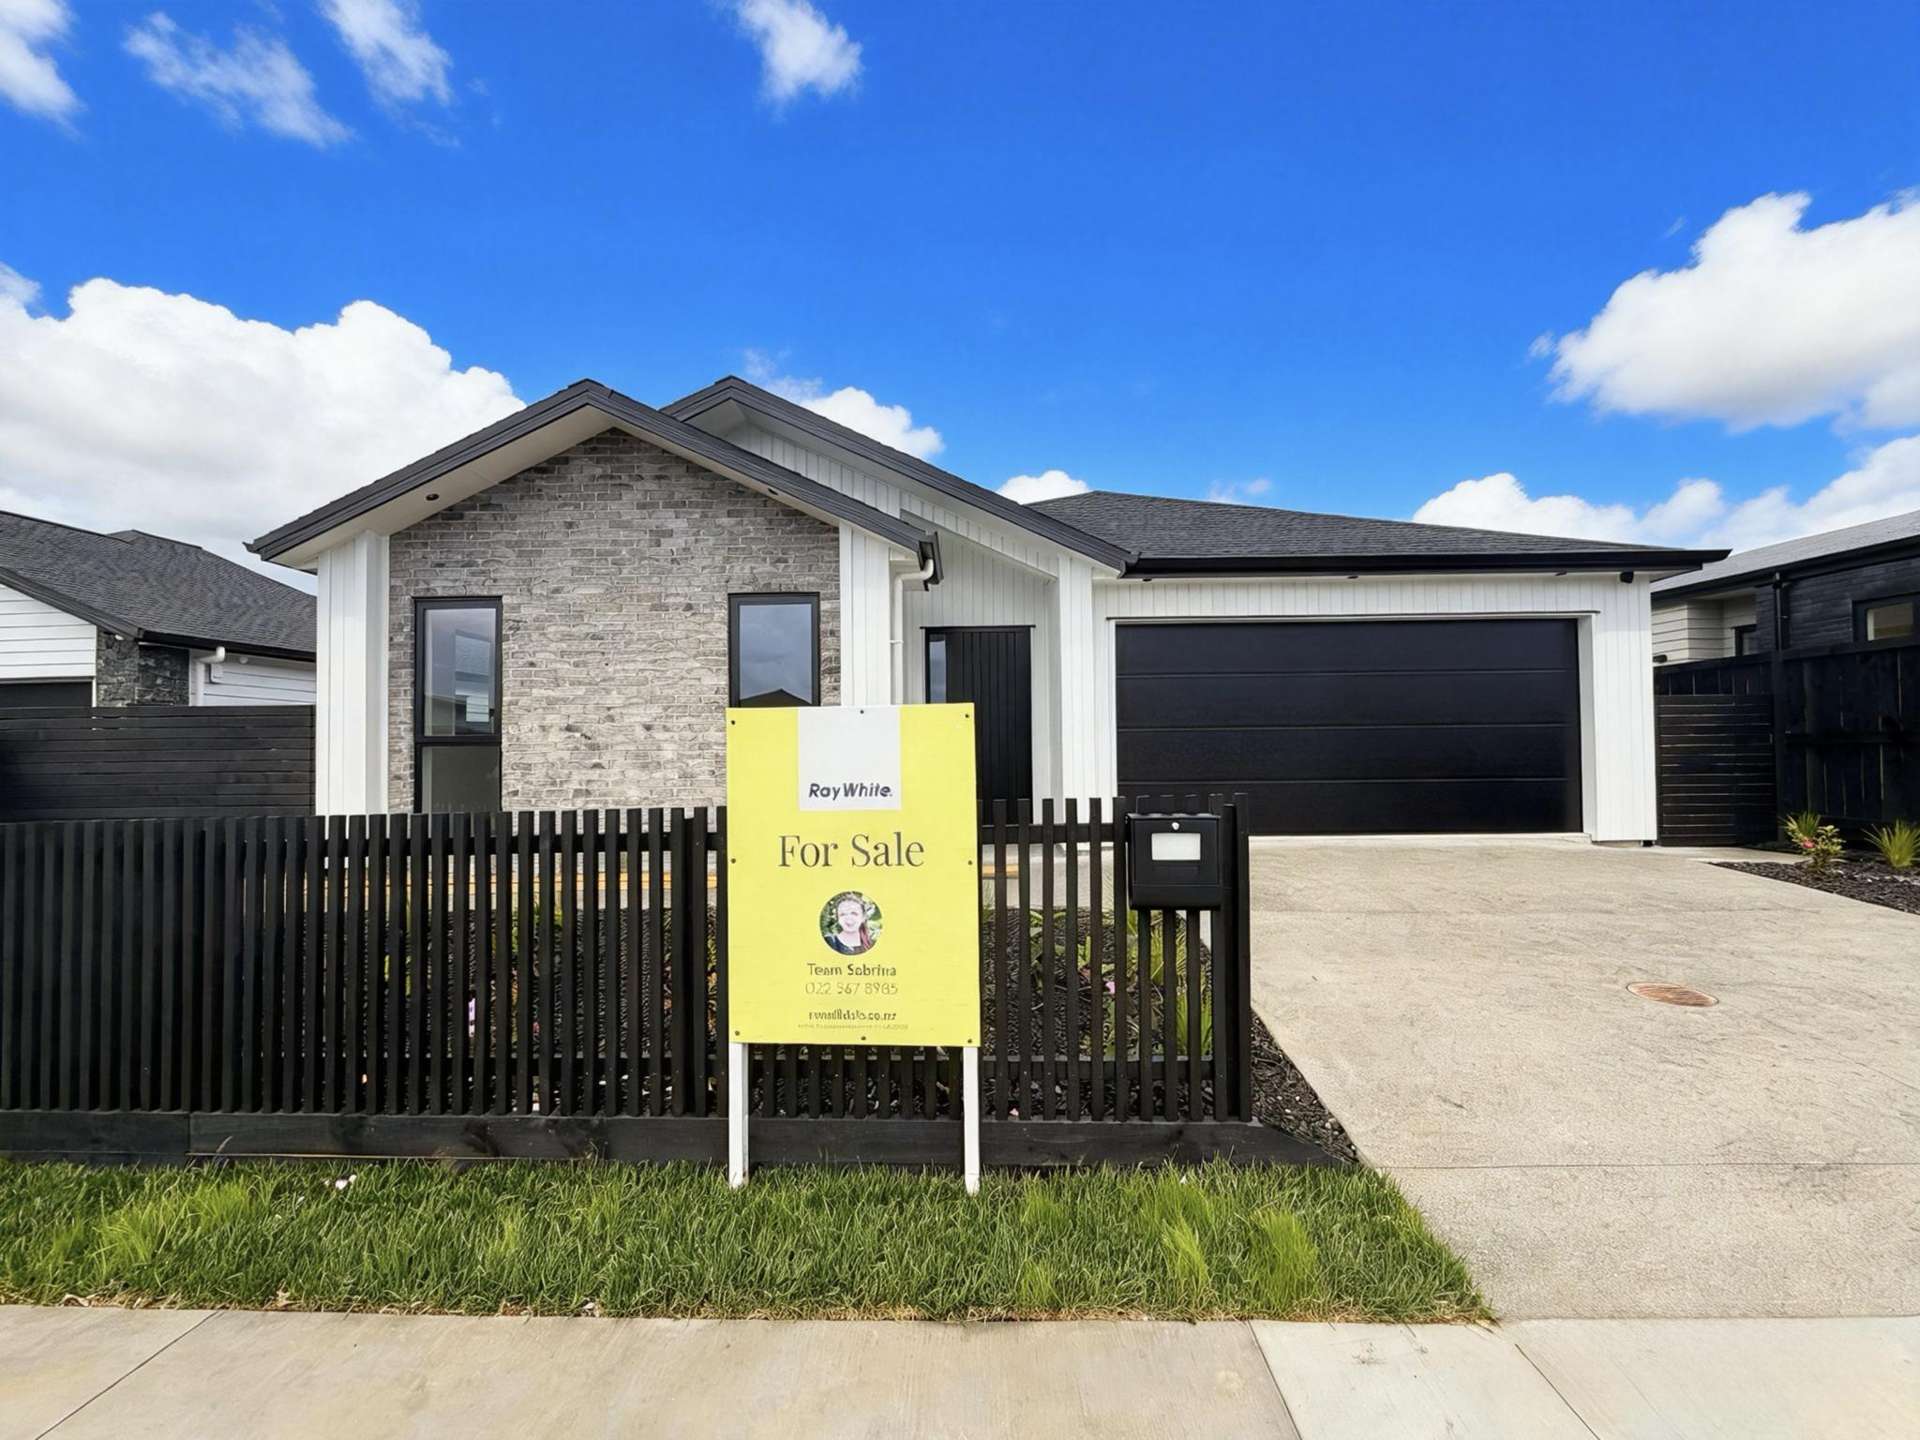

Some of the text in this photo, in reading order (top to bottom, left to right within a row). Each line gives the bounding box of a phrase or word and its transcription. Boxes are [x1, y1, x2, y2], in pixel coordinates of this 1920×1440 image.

[808, 783, 841, 801] Ray
[778, 831, 925, 868] For Sale
[807, 962, 843, 976] Team
